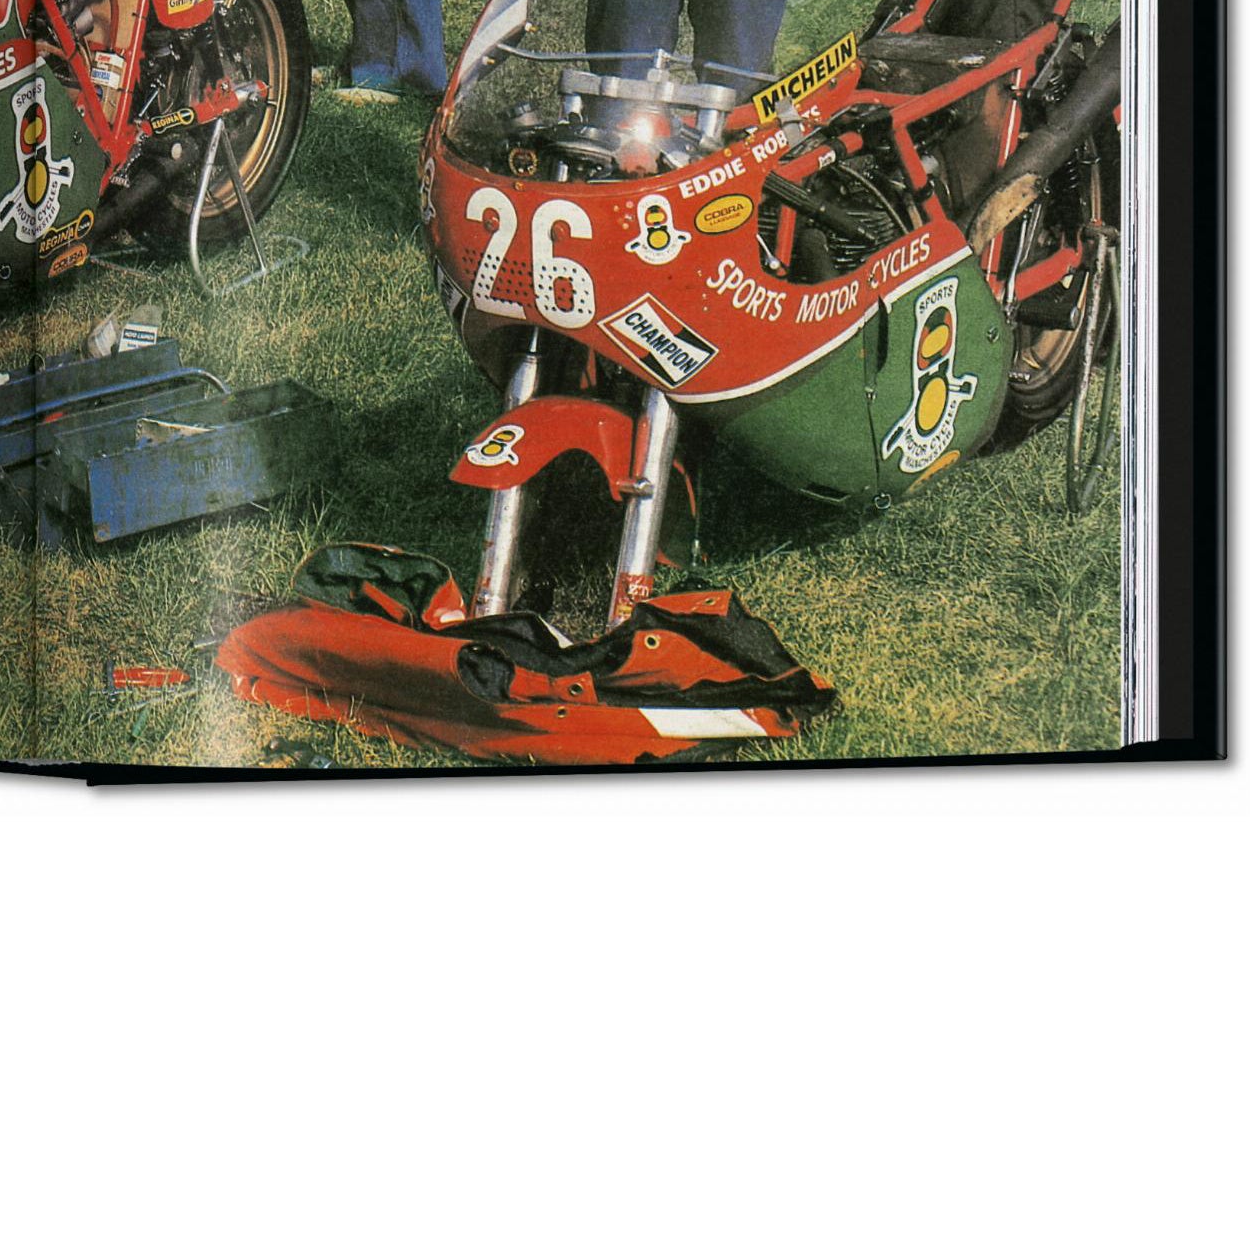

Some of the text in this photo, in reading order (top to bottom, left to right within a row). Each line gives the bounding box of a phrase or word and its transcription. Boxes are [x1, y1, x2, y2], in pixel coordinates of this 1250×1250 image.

[678, 156, 747, 199] EDDIE
[703, 203, 745, 222] COBRA
[38, 225, 76, 255] REGINA
[465, 186, 596, 329] 26
[706, 232, 931, 324] SPORTS MOTOR CYCLES
[918, 283, 954, 314] SPORTS
[624, 311, 698, 375] CHAMPION
